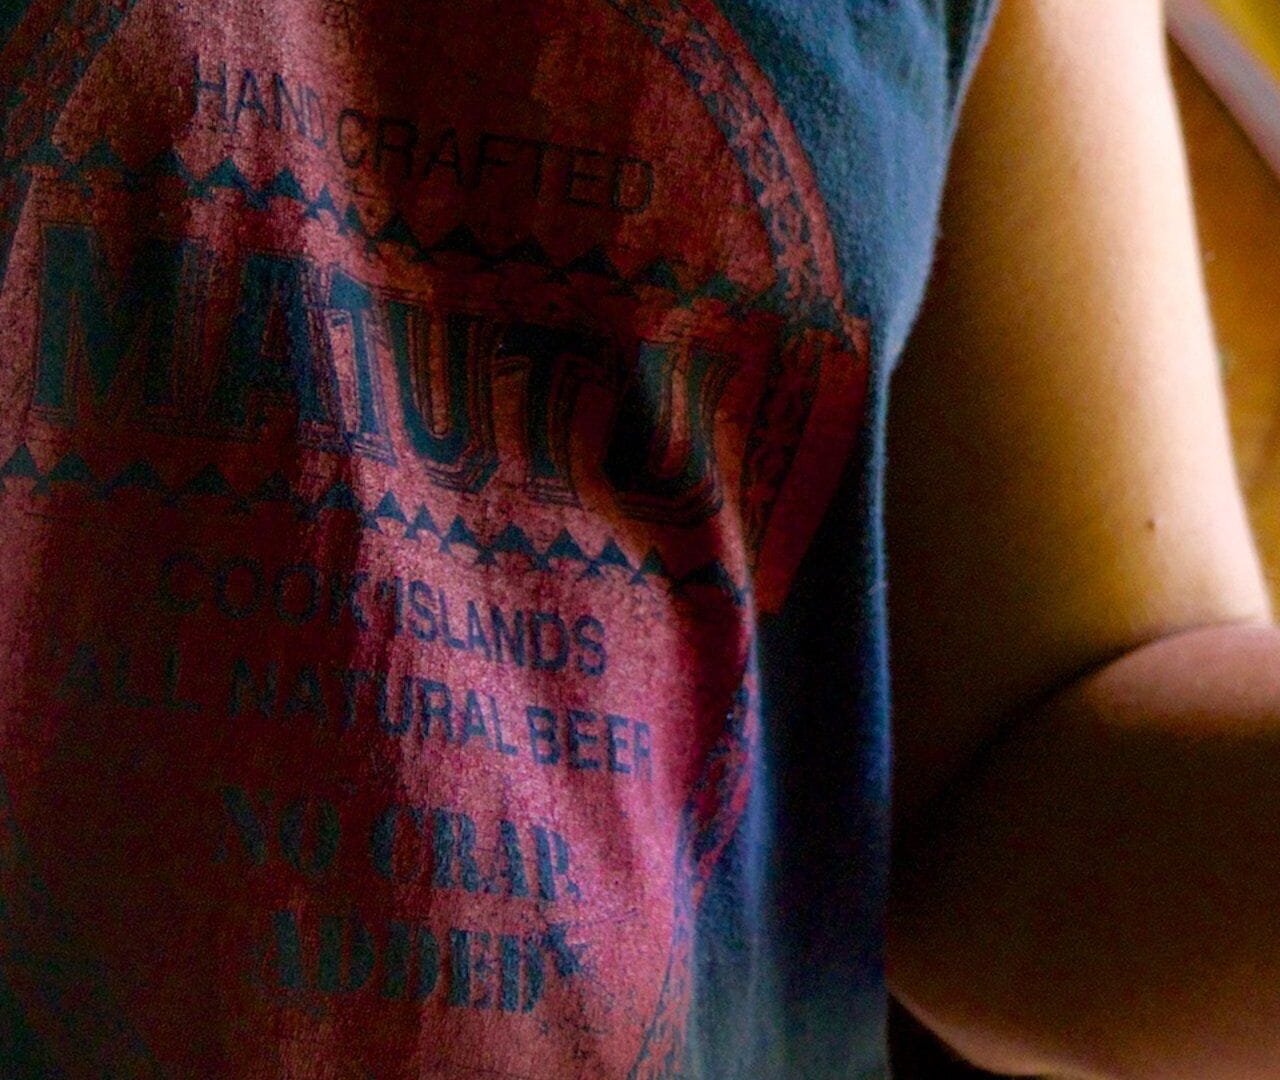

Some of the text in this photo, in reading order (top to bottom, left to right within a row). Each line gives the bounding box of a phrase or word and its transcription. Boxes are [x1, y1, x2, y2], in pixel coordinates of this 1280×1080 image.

[33, 222, 724, 526] MATUTU
[158, 552, 608, 678] COOK ISLANDS
[53, 641, 655, 780] ALL NATURAL BEER
[215, 783, 342, 880] NO
